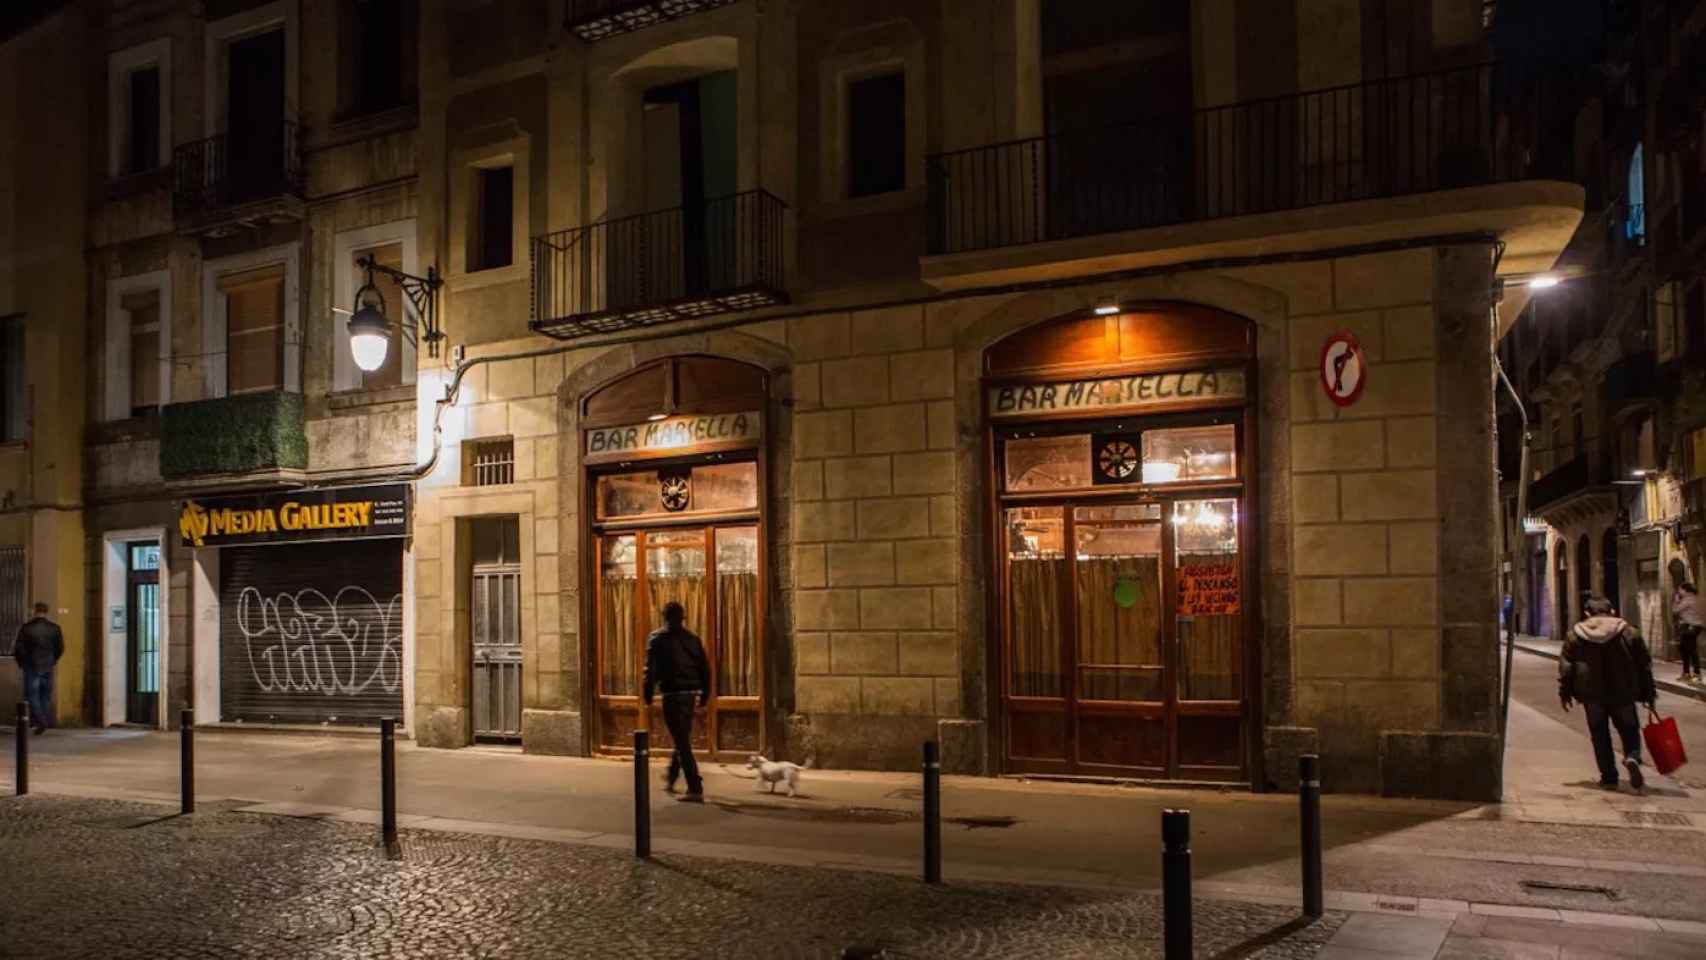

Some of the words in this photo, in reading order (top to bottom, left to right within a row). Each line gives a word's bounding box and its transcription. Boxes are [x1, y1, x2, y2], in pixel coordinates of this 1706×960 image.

[997, 385, 1056, 411] BAR
[1065, 371, 1219, 407] MASELLA
[590, 428, 638, 452] BAR
[644, 414, 748, 447] MARSELLA
